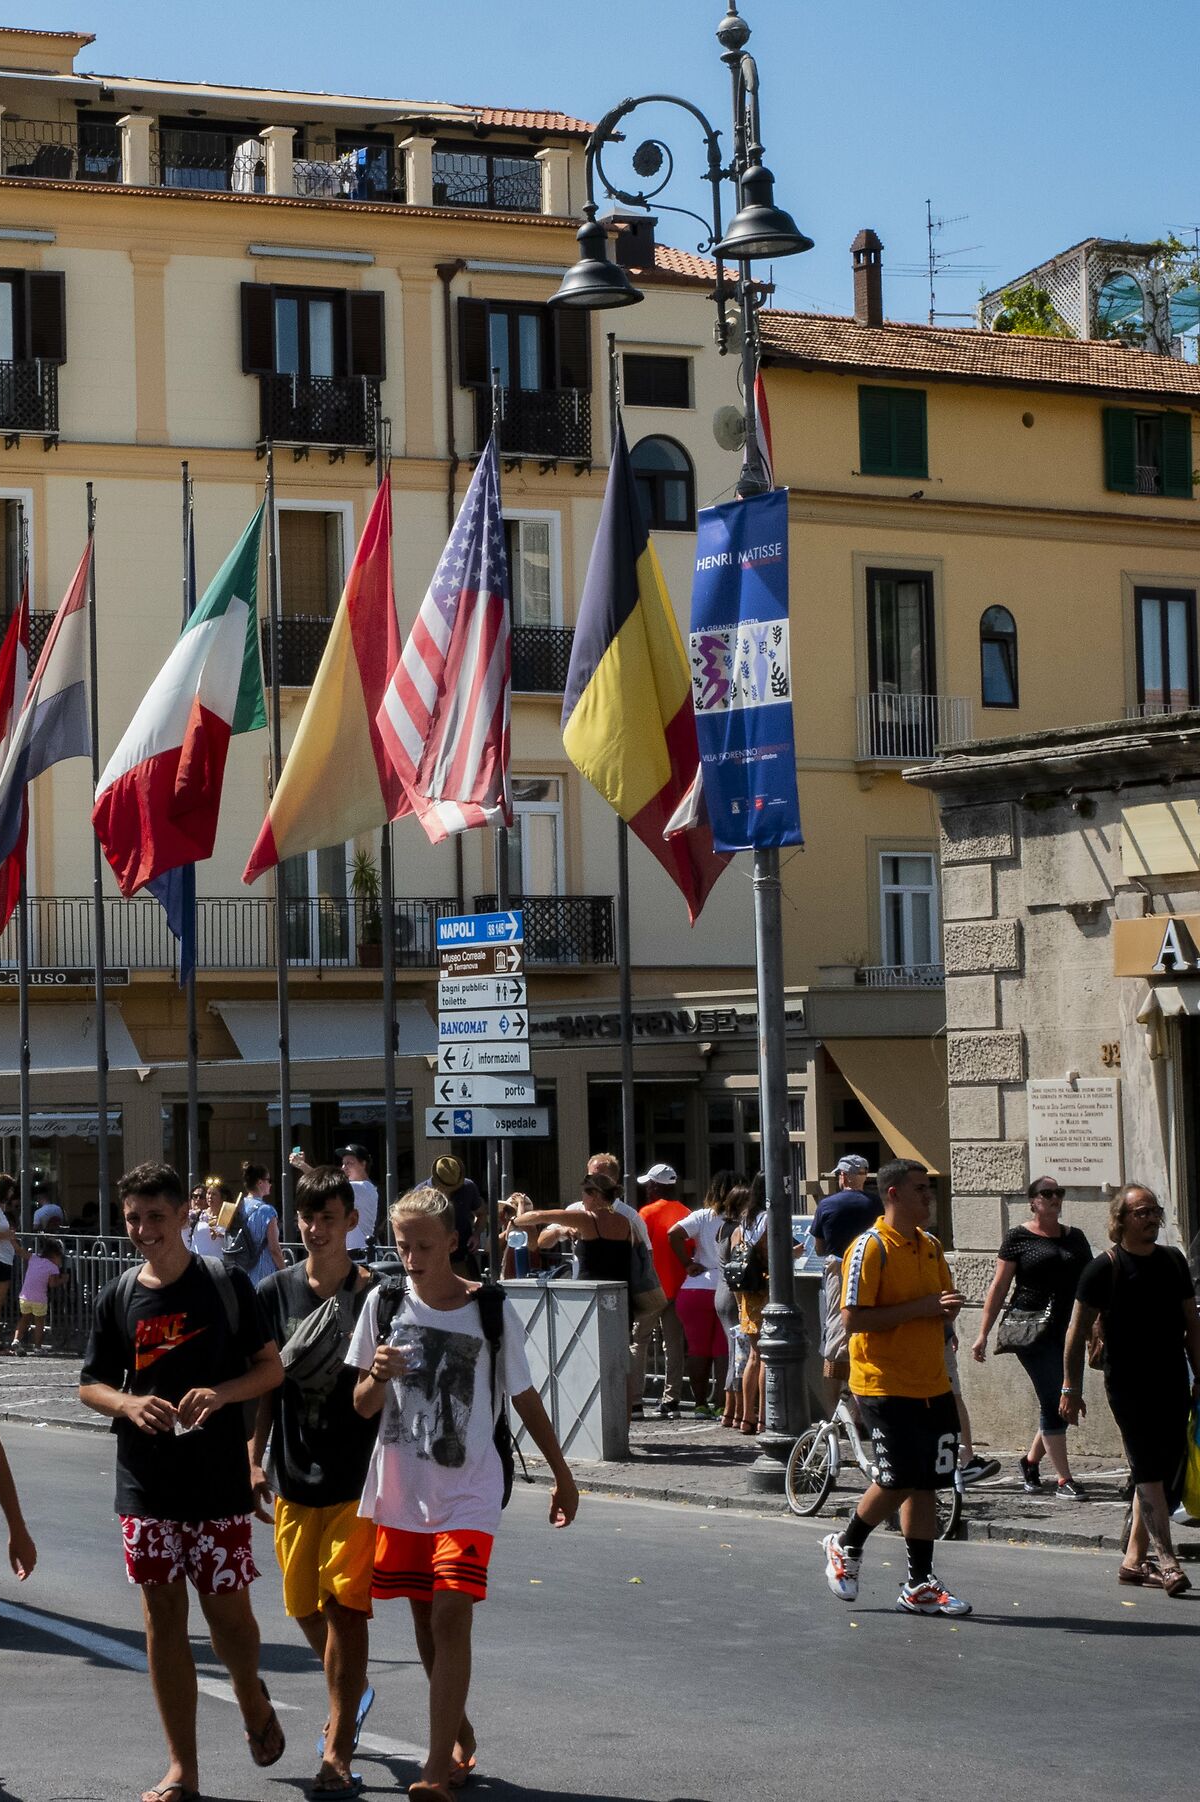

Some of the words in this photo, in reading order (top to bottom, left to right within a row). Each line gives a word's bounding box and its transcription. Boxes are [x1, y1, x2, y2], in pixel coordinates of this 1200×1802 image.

[696, 552, 732, 572] HENRI
[738, 542, 782, 564] MATISSE
[440, 921, 475, 939] NAPOLI
[488, 924, 496, 936] SS
[496, 922, 505, 935] 145
[442, 953, 461, 963] Museo
[462, 951, 486, 961] Correale
[454, 963, 478, 971] Terranova
[441, 983, 460, 994] bagni
[462, 982, 489, 993] pubblici
[442, 997, 467, 1006] toilette
[440, 1021, 488, 1035] BANCOMAT
[478, 1051, 521, 1065] informazioni
[504, 1085, 526, 1099] porto
[495, 1117, 537, 1131] ospedale
